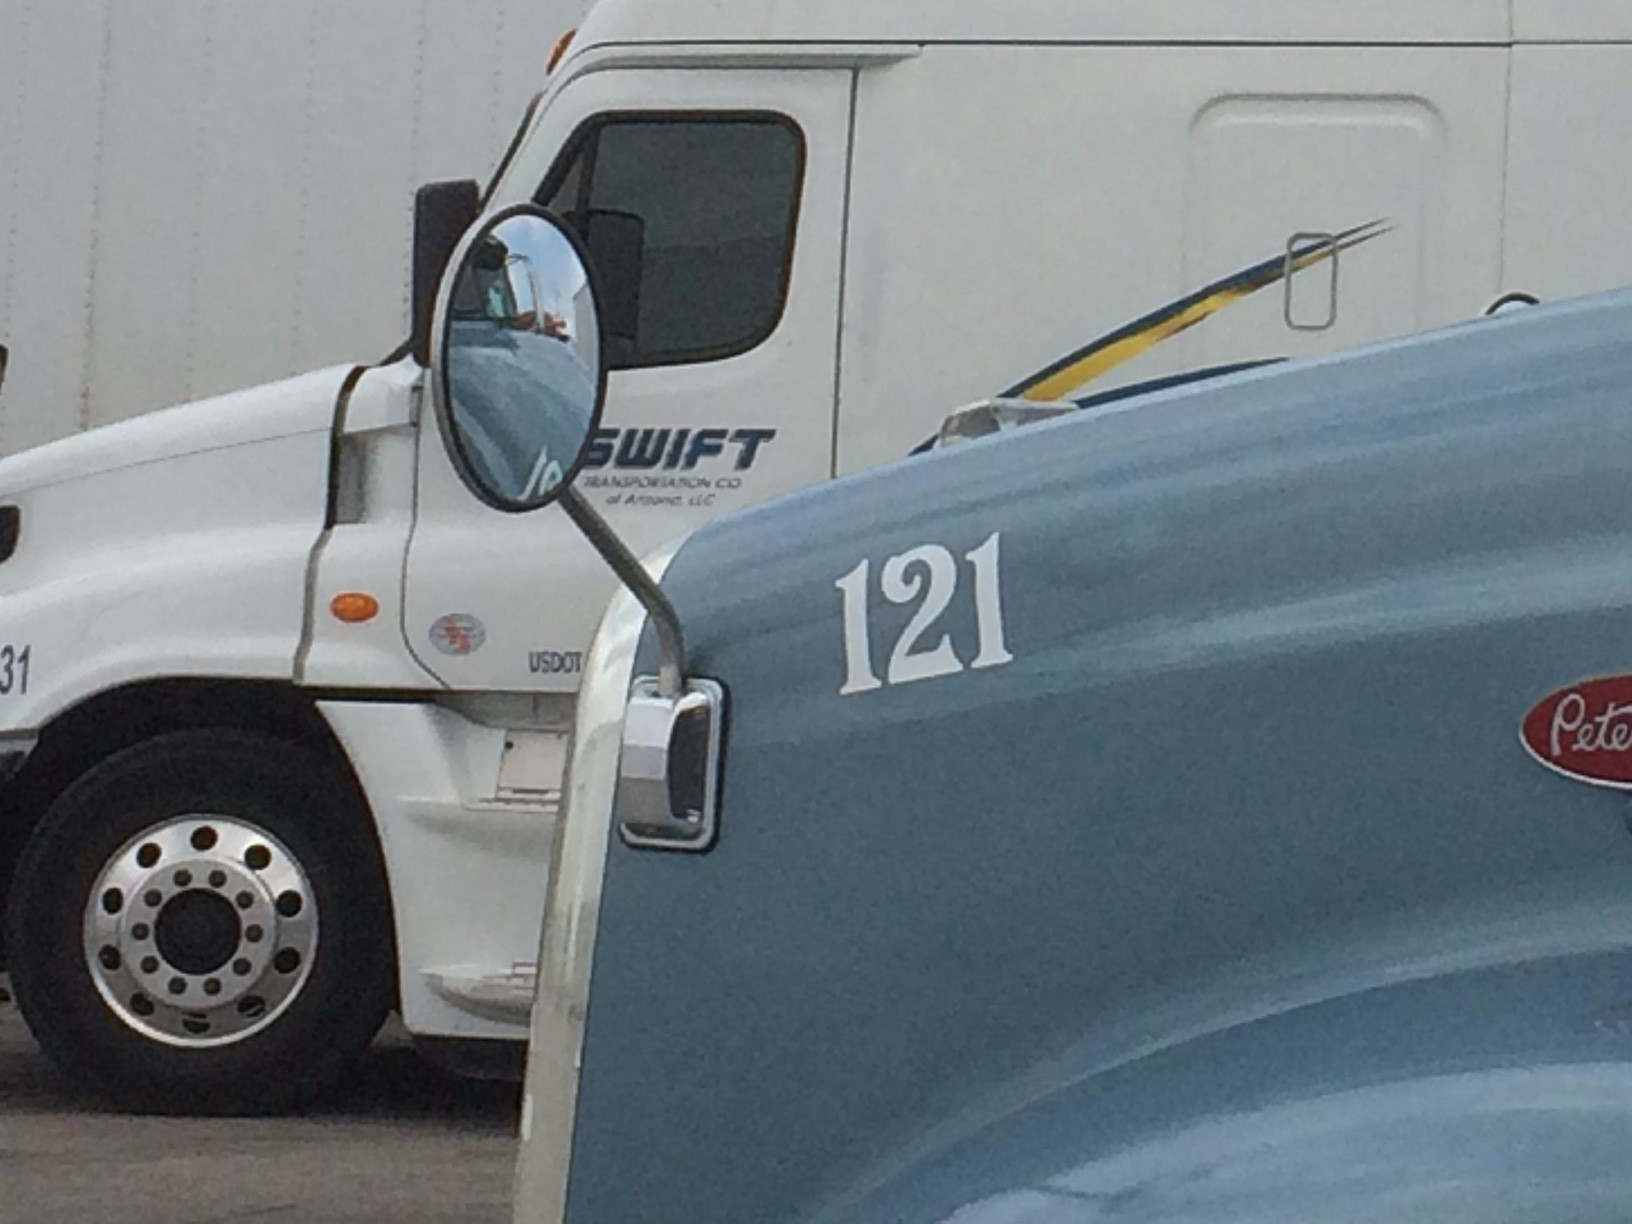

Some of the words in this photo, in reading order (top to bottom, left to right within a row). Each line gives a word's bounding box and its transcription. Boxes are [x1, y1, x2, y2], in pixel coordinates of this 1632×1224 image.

[582, 428, 777, 470] SWIFT
[835, 532, 1013, 695] 121
[0, 644, 31, 695] 31
[528, 650, 583, 673] USDOT
